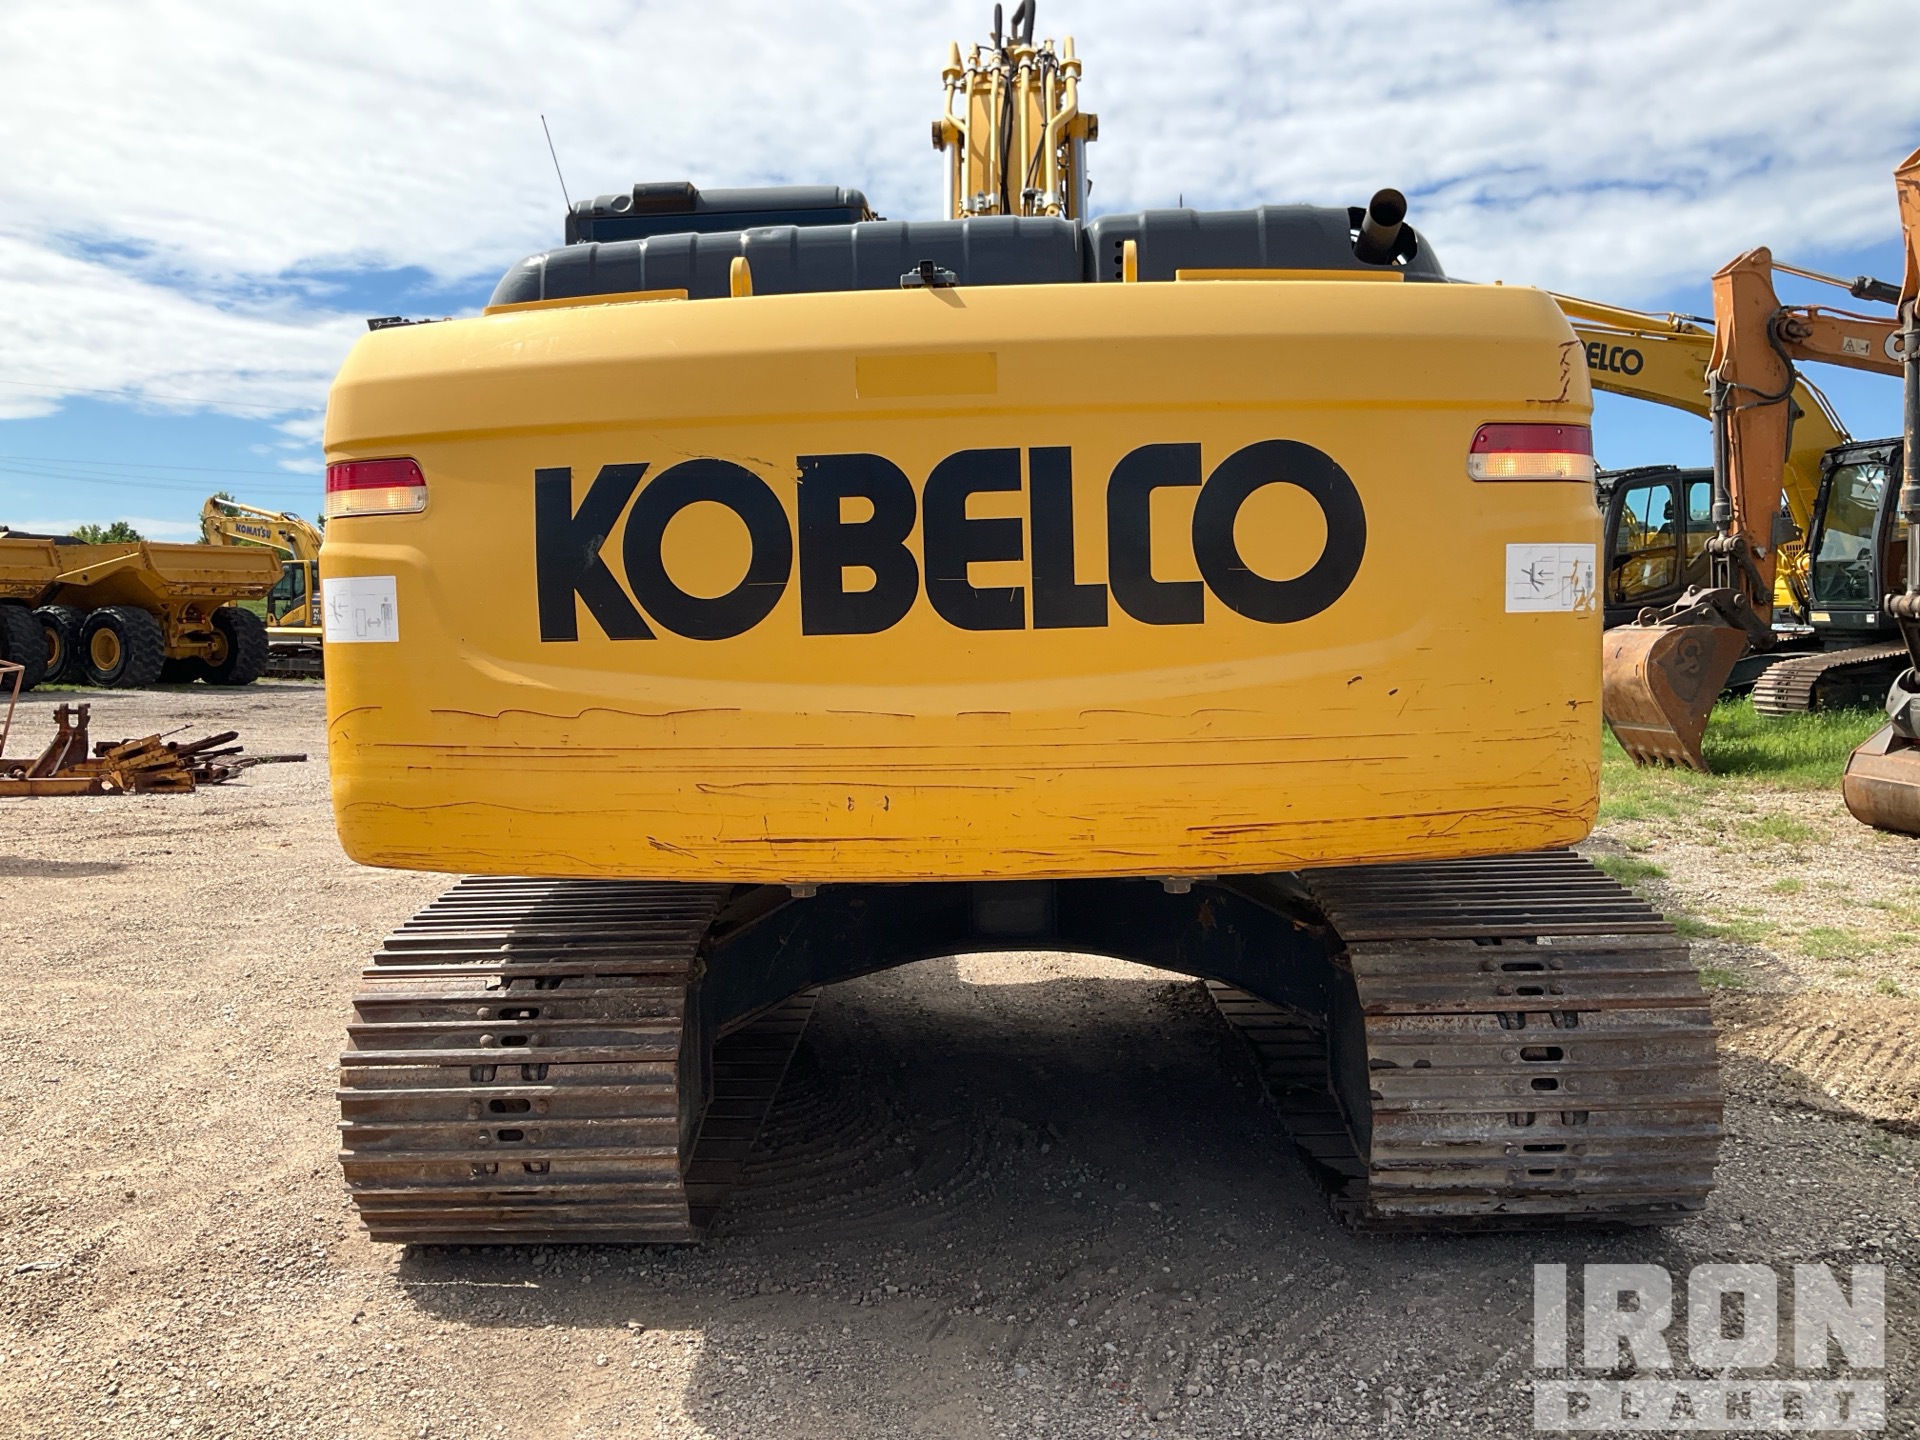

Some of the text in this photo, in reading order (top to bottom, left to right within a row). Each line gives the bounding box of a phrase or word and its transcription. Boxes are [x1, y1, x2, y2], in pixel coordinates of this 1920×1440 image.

[1580, 339, 1644, 376] ELCO
[235, 523, 271, 539] KOMATSU
[534, 439, 1367, 643] KOBELCO
